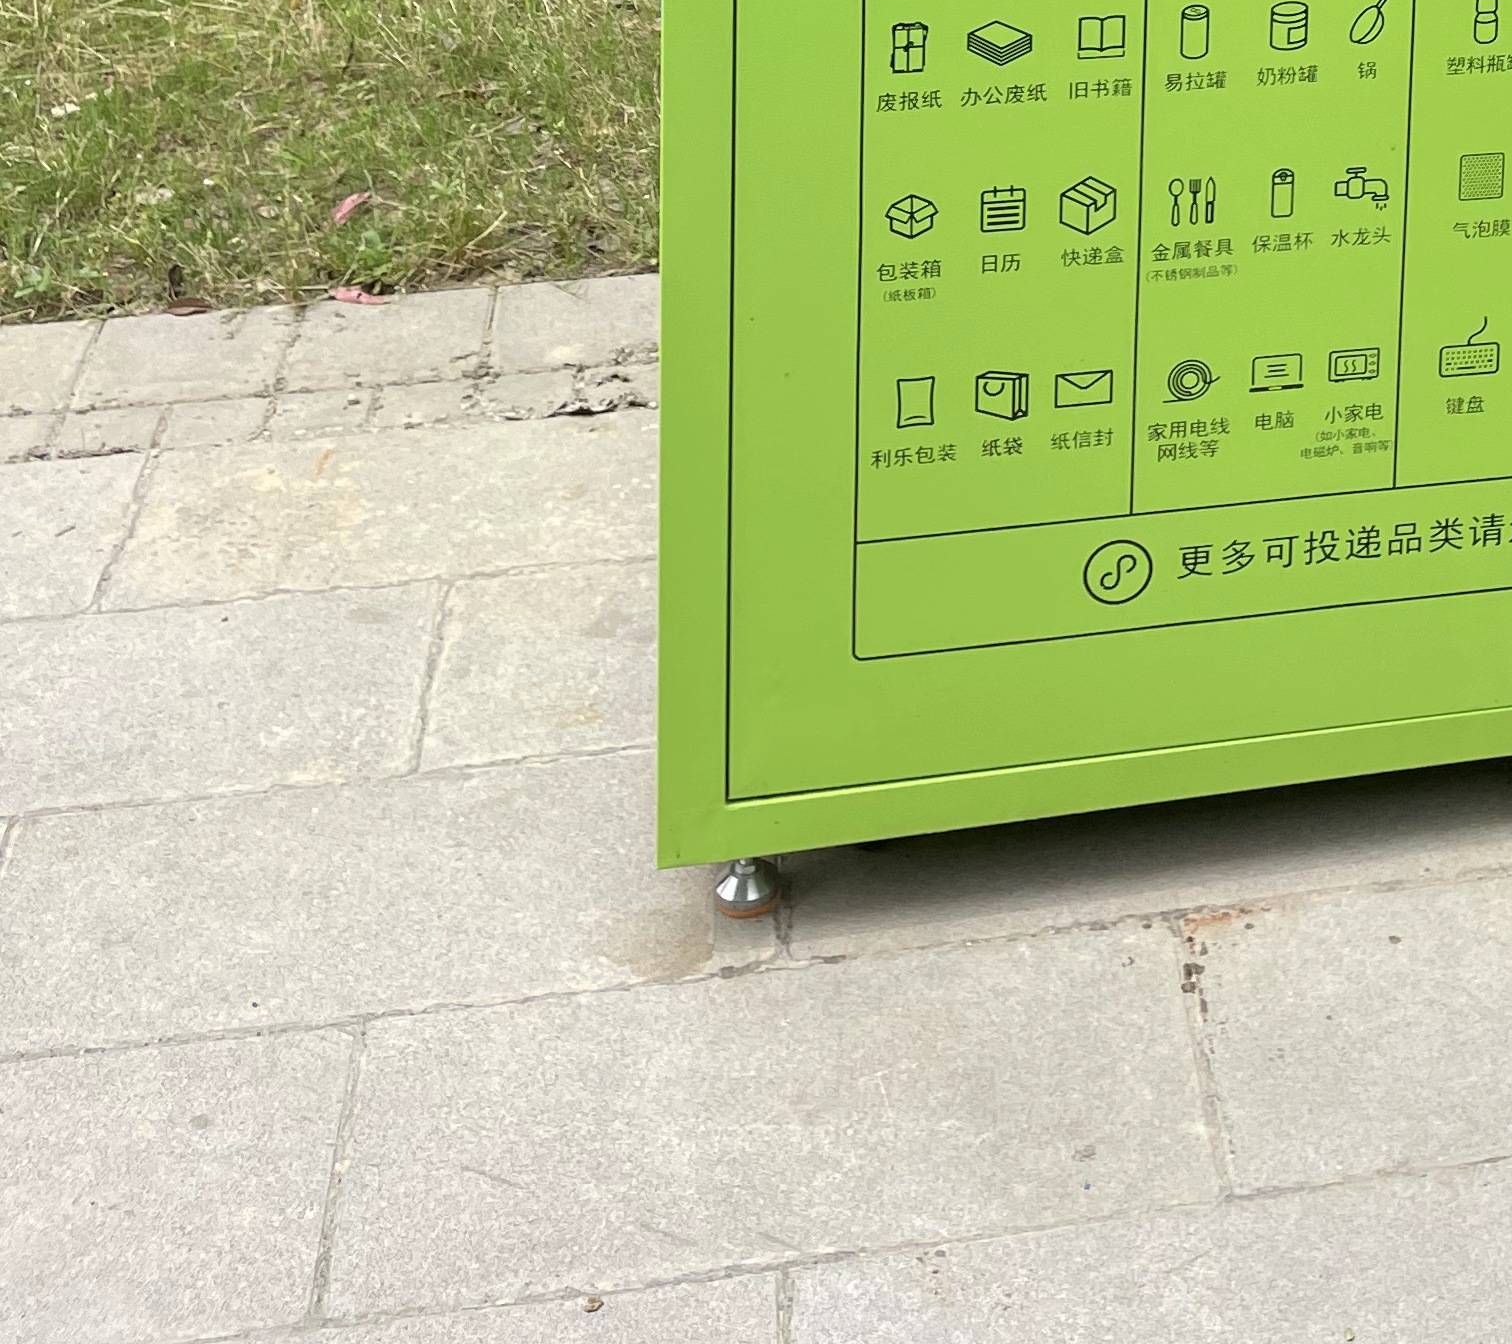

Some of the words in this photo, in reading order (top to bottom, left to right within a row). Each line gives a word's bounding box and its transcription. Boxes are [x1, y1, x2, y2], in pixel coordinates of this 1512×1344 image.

[1164, 70, 1228, 93] 易拉罐
[1256, 65, 1320, 87] 奶粉罐
[1357, 61, 1378, 81] 锅
[960, 82, 1048, 108] 办公废纸
[1068, 78, 1134, 100] 旧书籍
[876, 90, 943, 113] 废报纸
[1331, 225, 1392, 248] 水龙头
[1452, 218, 1512, 240] 气泡膜
[1151, 238, 1235, 262] 金属餐具
[1251, 230, 1314, 254] 保温杯
[981, 252, 1022, 274] 日历
[1060, 244, 1126, 268] 快递盒
[876, 260, 942, 283] 包装箱
[1324, 402, 1385, 424] 小家电
[1445, 395, 1486, 416] 键盘
[1147, 417, 1231, 443] 家用电线
[1254, 412, 1295, 431] 电脑
[981, 436, 1023, 459] 纸袋
[1050, 427, 1115, 451] 纸信封
[1157, 439, 1220, 462] 网线等
[870, 444, 957, 469] 利乐包装
